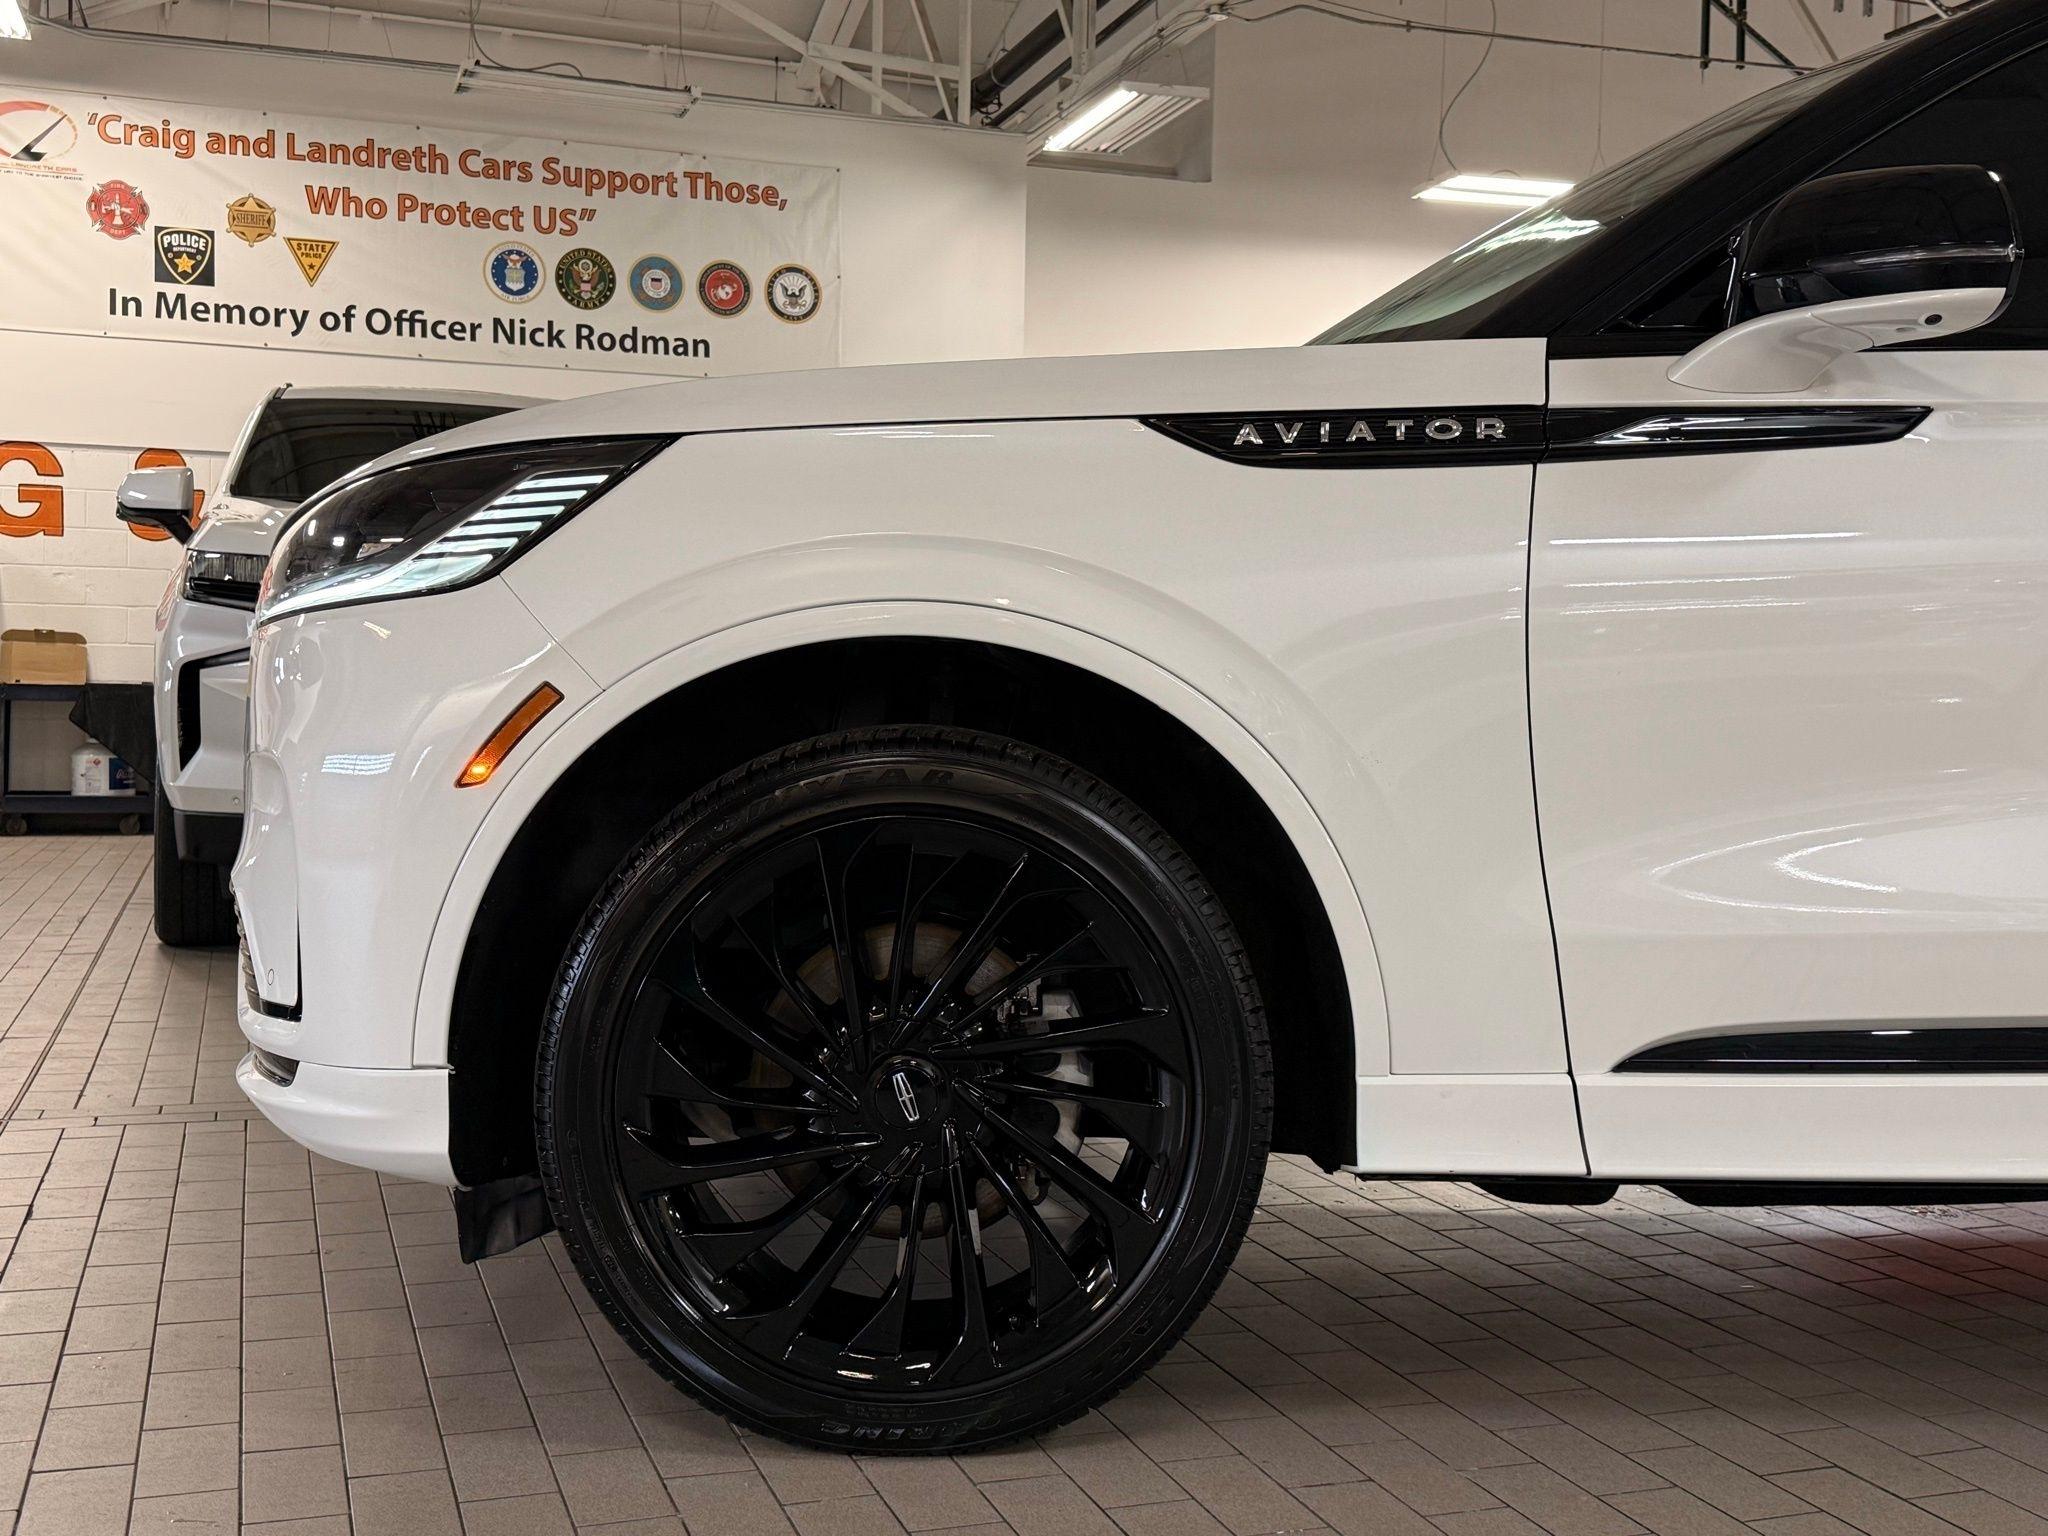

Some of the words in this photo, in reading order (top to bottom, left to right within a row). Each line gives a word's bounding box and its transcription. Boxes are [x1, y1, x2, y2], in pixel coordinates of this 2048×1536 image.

[206, 129, 276, 158] and
[286, 132, 449, 175] Landreth
[459, 148, 533, 183] Cars
[541, 156, 678, 199] Support
[683, 171, 788, 212] Those,
[235, 212, 267, 226] SHERIFF
[304, 184, 388, 220] Who
[397, 193, 524, 232] Protect
[162, 233, 207, 251] POLICE
[296, 242, 327, 253] STATE
[572, 299, 600, 309] ARMY
[109, 288, 142, 318] In
[155, 291, 310, 337] Memory
[319, 304, 357, 333] of
[365, 307, 483, 342] Officer
[492, 316, 566, 349] Nick
[575, 323, 711, 358] Rodman
[1233, 417, 1506, 446] AVIATOR
